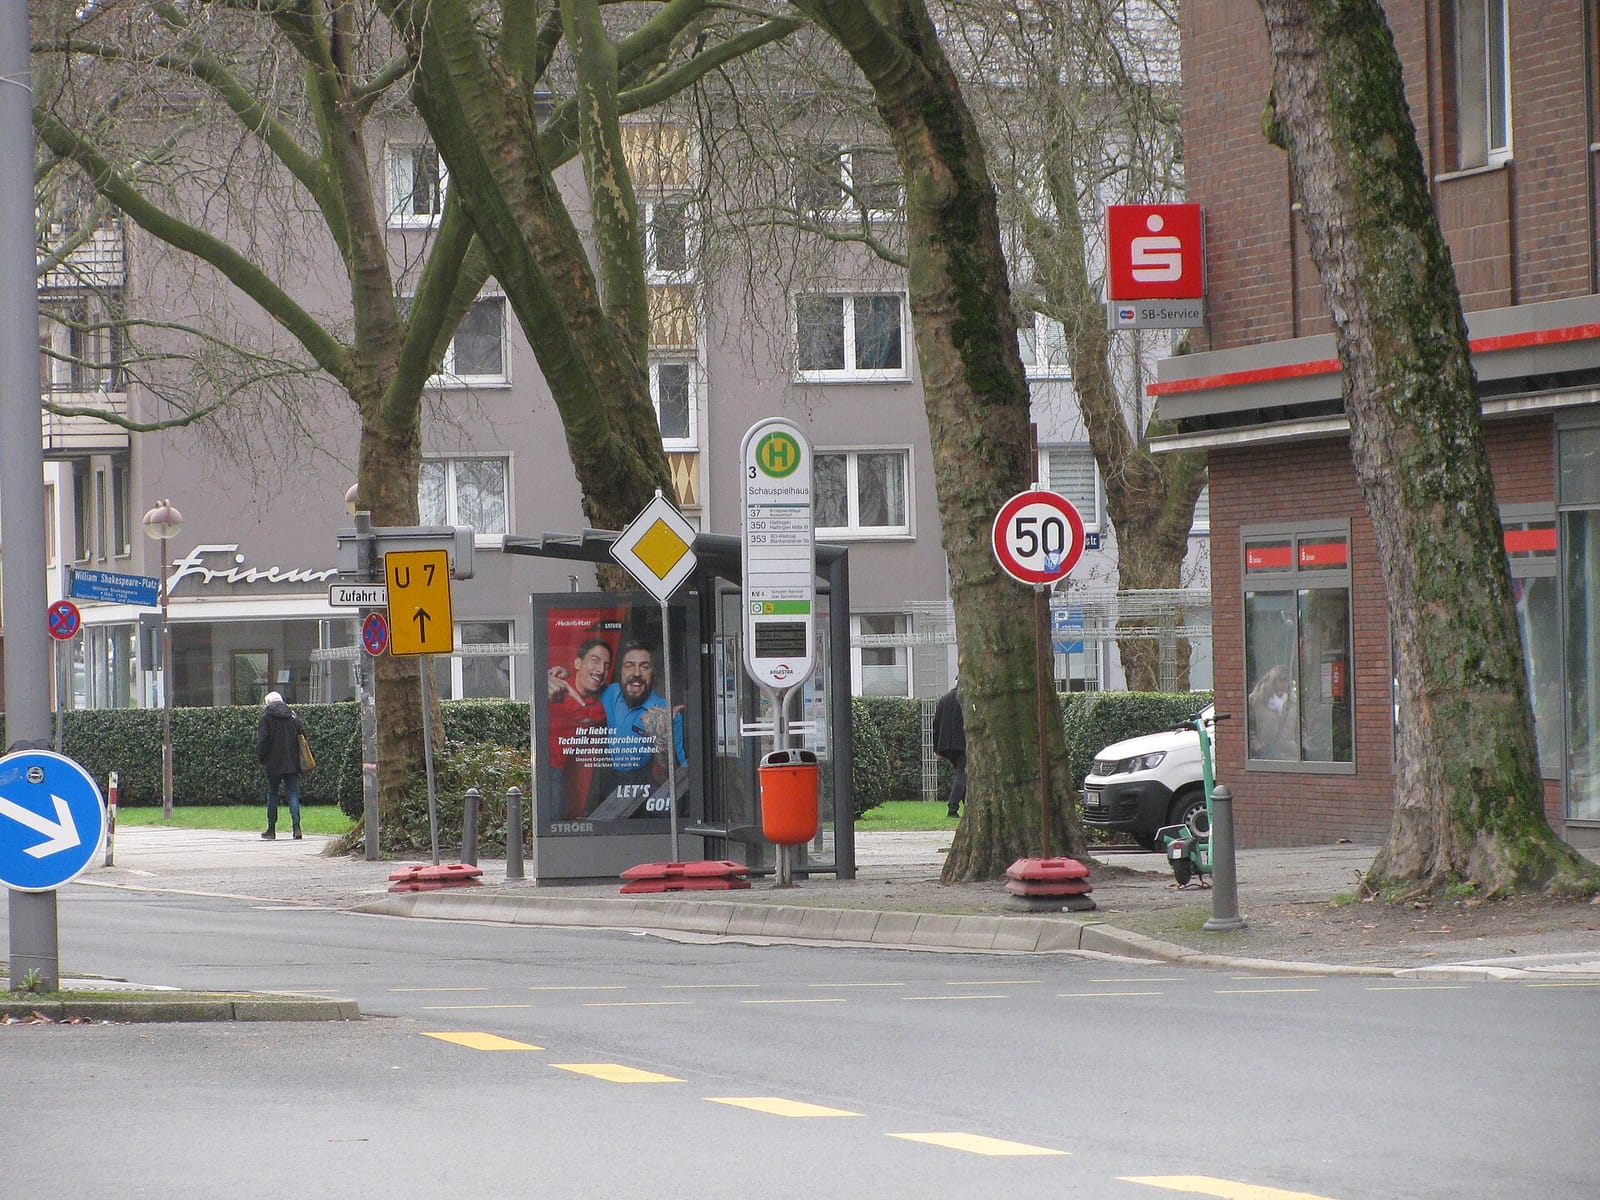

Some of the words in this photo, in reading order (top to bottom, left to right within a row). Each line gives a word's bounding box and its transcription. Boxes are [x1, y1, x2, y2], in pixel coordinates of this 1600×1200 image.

[1142, 309, 1199, 320] SB-Service
[769, 442, 788, 467] H
[748, 466, 756, 478] 3
[748, 486, 808, 496] Schauspielhaus
[750, 509, 760, 517] 37
[750, 521, 766, 529] 350
[751, 535, 766, 543] 353
[1016, 516, 1064, 558] 50
[167, 544, 338, 596] Friseur
[395, 566, 410, 588] U
[424, 564, 435, 586] 7
[75, 571, 97, 582] William
[101, 574, 157, 589] Shakespeare-Platz
[340, 590, 376, 602] Zufahrt
[576, 727, 588, 735] Ihr
[588, 727, 607, 735] liebt
[558, 737, 589, 745] Technik
[590, 736, 656, 745] auszuprobieren?
[616, 784, 650, 798] LET'S
[645, 798, 671, 811] GO!
[550, 822, 594, 832] STRÖER
